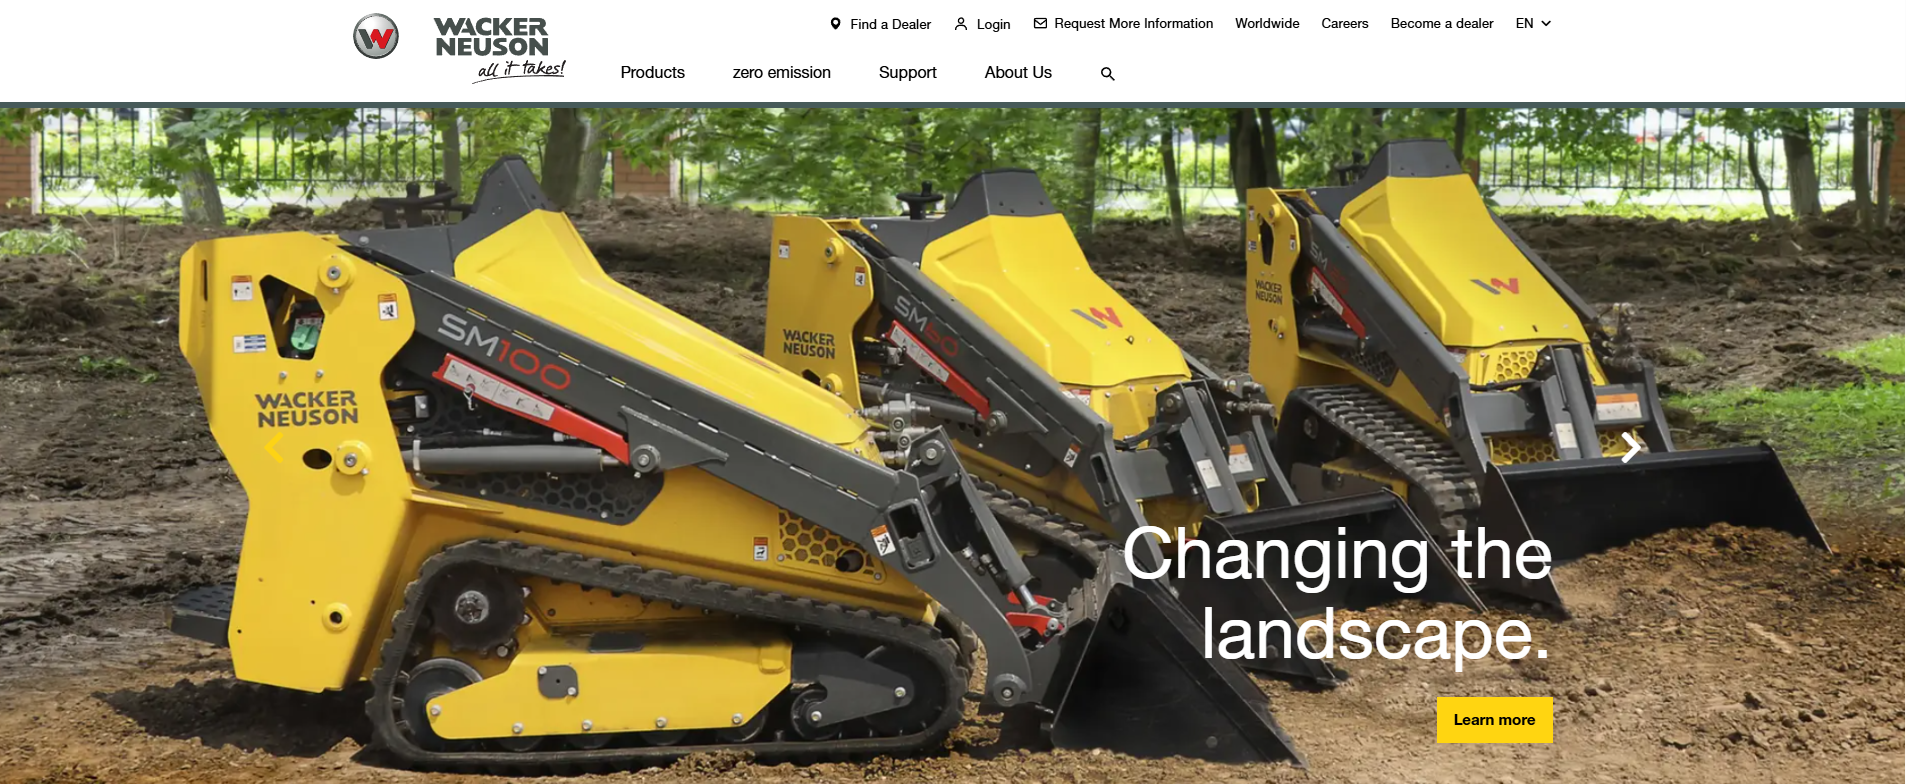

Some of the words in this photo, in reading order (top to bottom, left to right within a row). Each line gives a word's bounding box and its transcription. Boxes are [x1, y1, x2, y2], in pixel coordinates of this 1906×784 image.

[1255, 278, 1283, 294] WACKER
[1255, 290, 1283, 305] NEUSON
[783, 328, 836, 347] WACKER
[437, 313, 571, 390] SM100
[783, 342, 836, 360] NEUSON
[254, 390, 357, 409] WACKER
[257, 408, 359, 429] NEUSON
